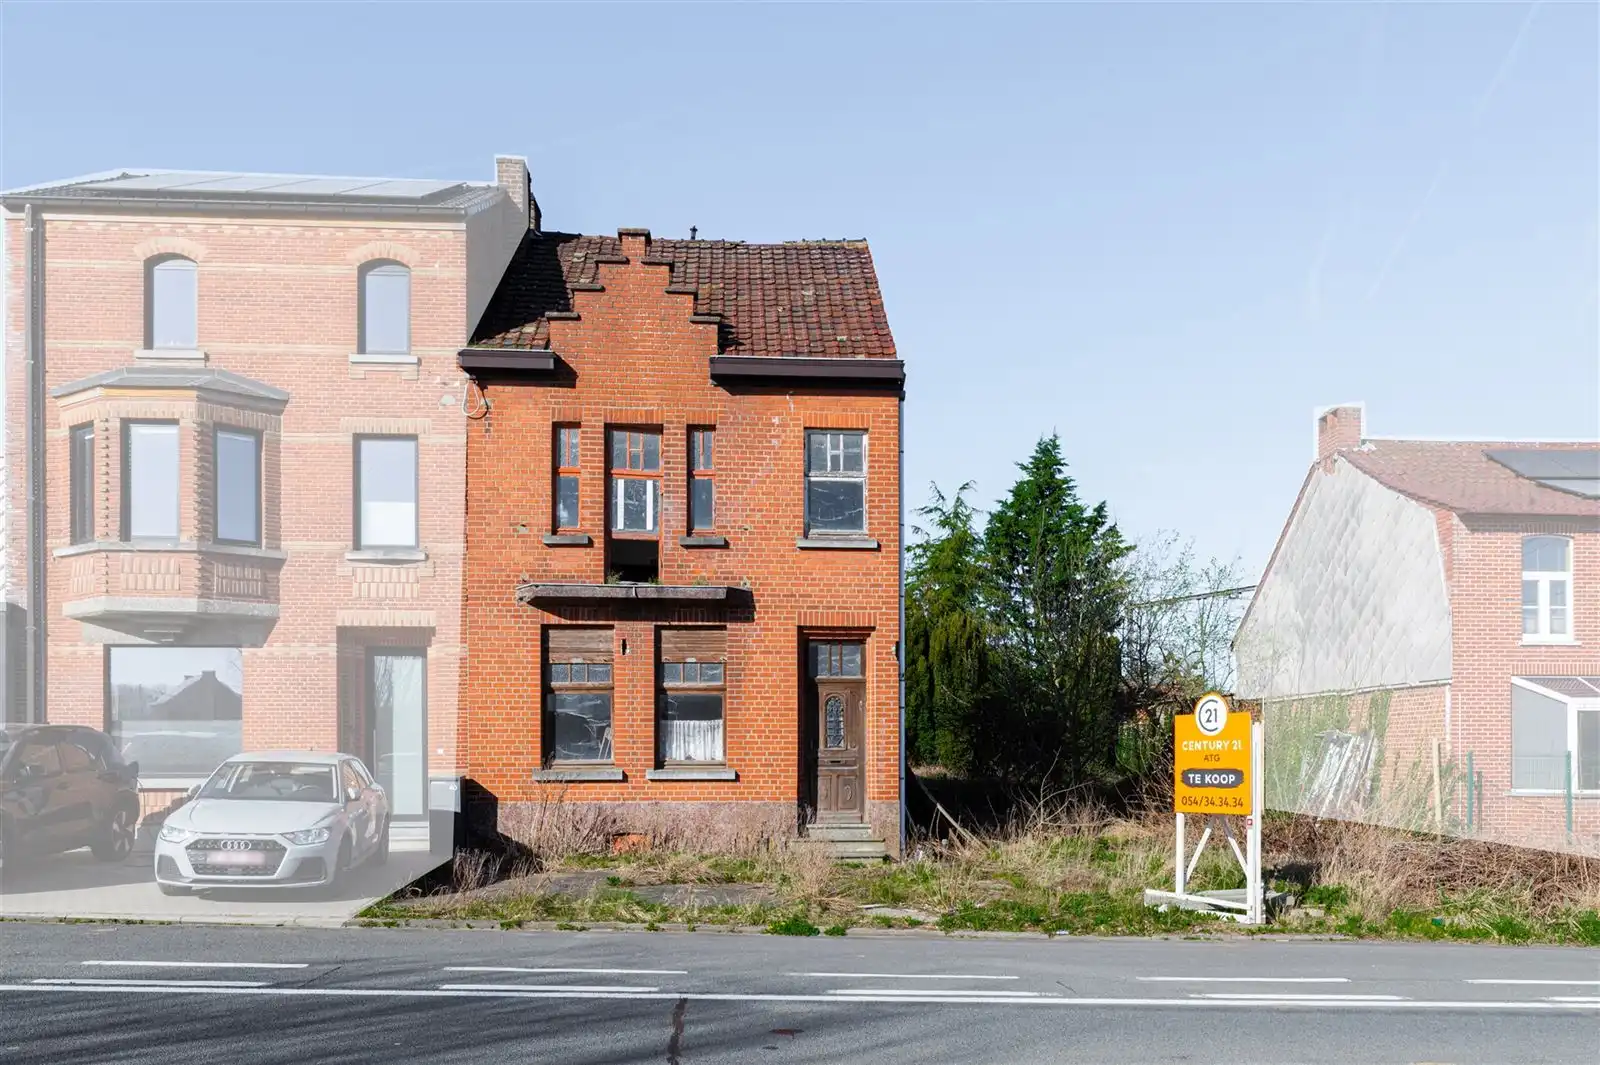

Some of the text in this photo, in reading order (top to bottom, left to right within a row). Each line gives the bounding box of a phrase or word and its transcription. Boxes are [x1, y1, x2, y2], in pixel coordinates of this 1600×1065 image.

[1182, 741, 1229, 751] CENTURY
[1203, 754, 1220, 762] ATG
[1188, 774, 1235, 784] TE KOOP
[1181, 795, 1243, 807] 054/34.34.34
